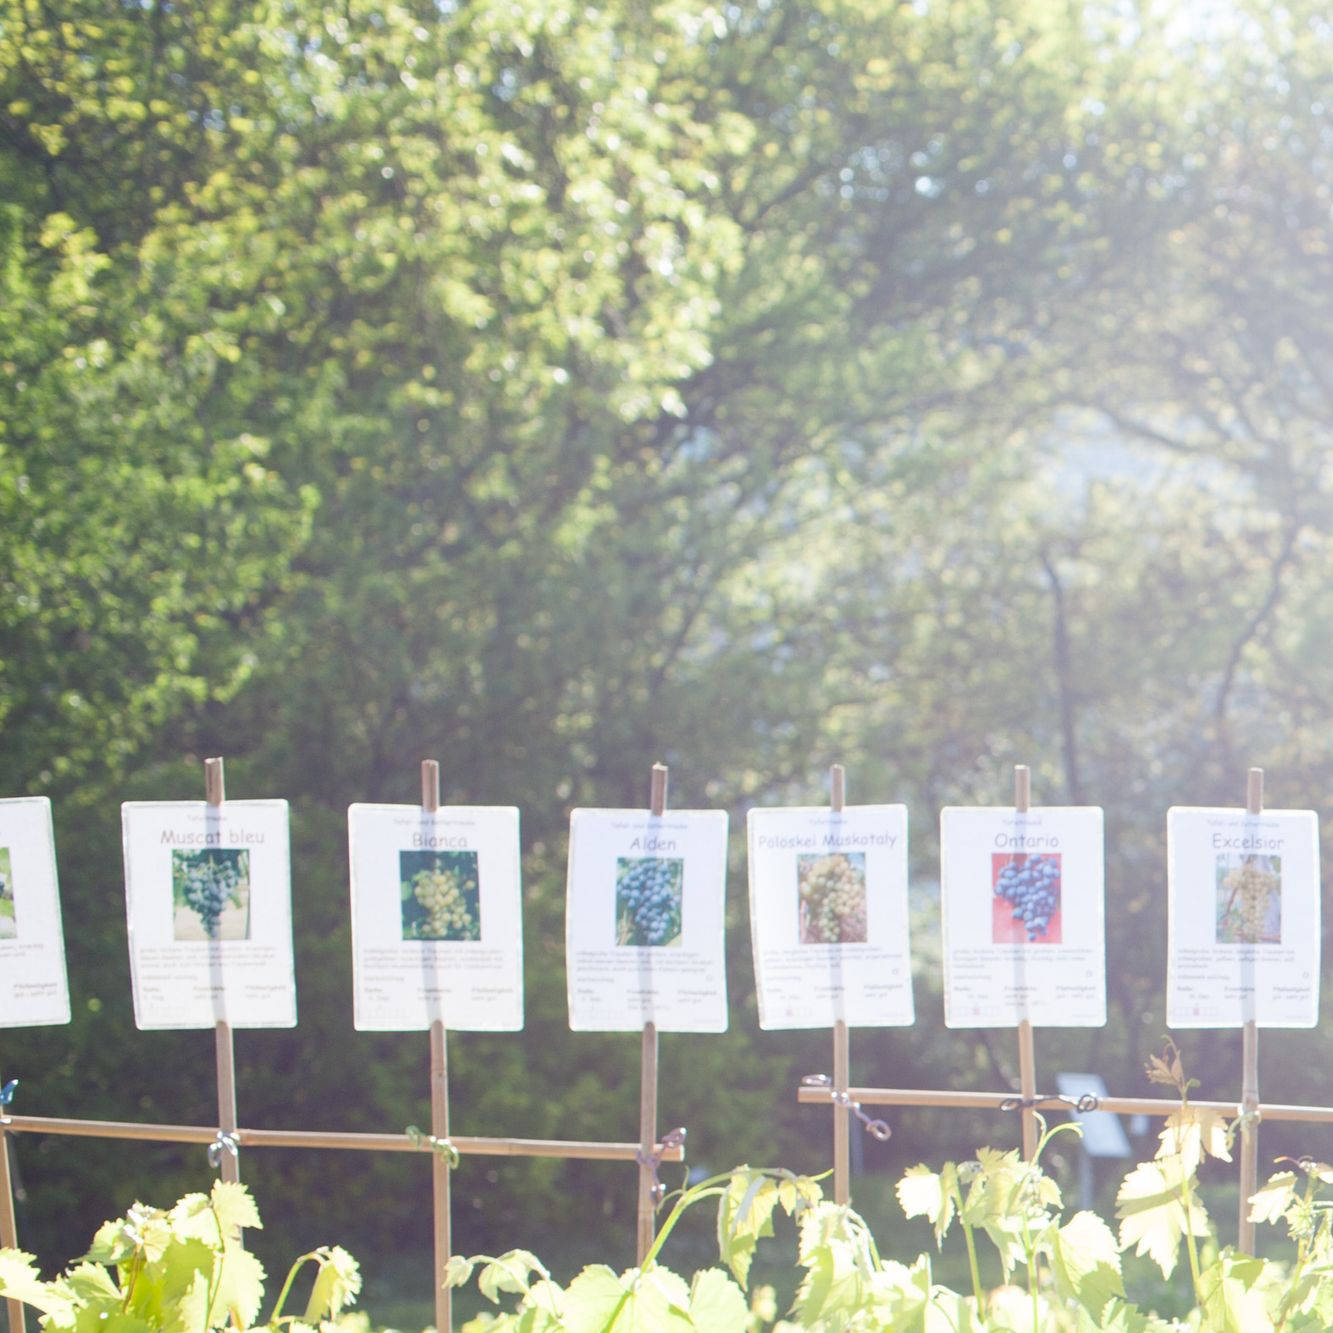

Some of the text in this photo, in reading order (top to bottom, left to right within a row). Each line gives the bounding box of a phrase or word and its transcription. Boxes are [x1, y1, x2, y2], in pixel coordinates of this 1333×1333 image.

[160, 828, 266, 845] Muscat bleu
[412, 832, 468, 848] Bianca
[630, 836, 677, 851] Alden
[994, 832, 1060, 848] Ontario
[1212, 832, 1285, 849] Excelsior
